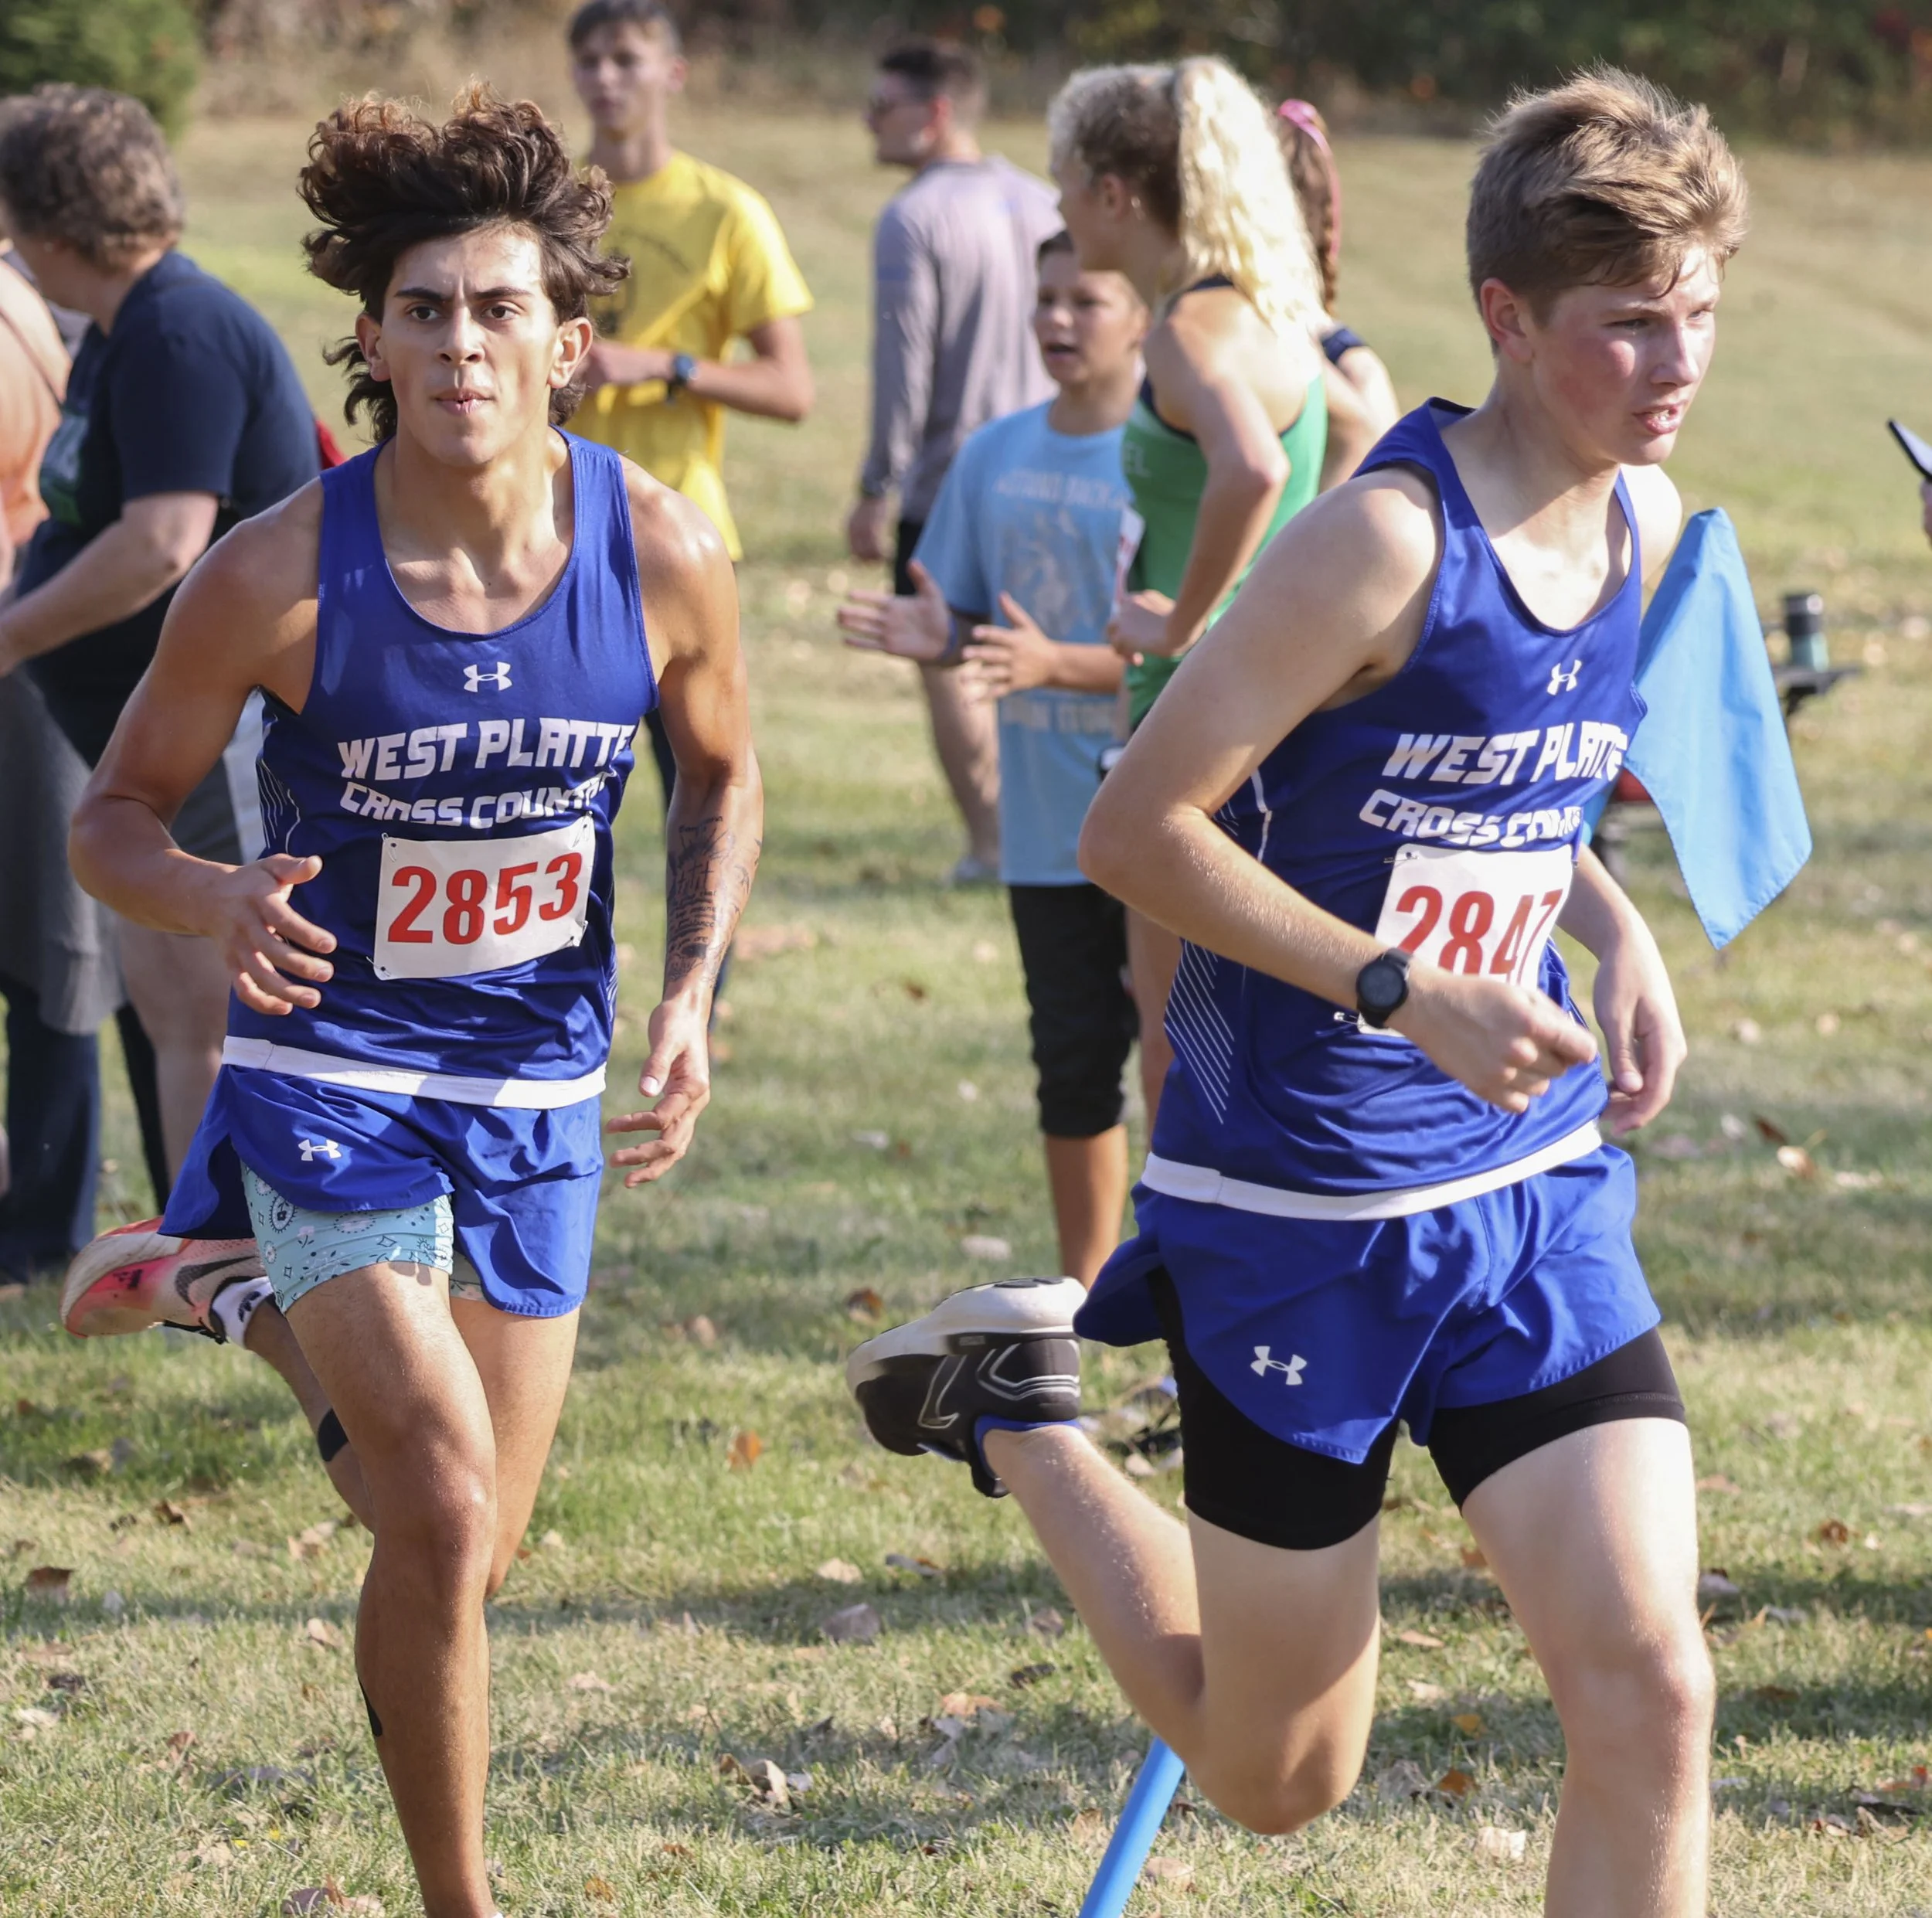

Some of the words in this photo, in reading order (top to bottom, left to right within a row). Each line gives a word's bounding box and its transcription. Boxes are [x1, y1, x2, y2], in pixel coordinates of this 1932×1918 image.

[338, 723, 468, 780] WEST
[1382, 729, 1539, 785] WEST
[1531, 721, 1628, 784] PLATTE
[339, 781, 464, 827] CROSS
[1359, 789, 1500, 845] CROSS
[387, 852, 583, 945] 2853
[1396, 886, 1563, 985] 2847
